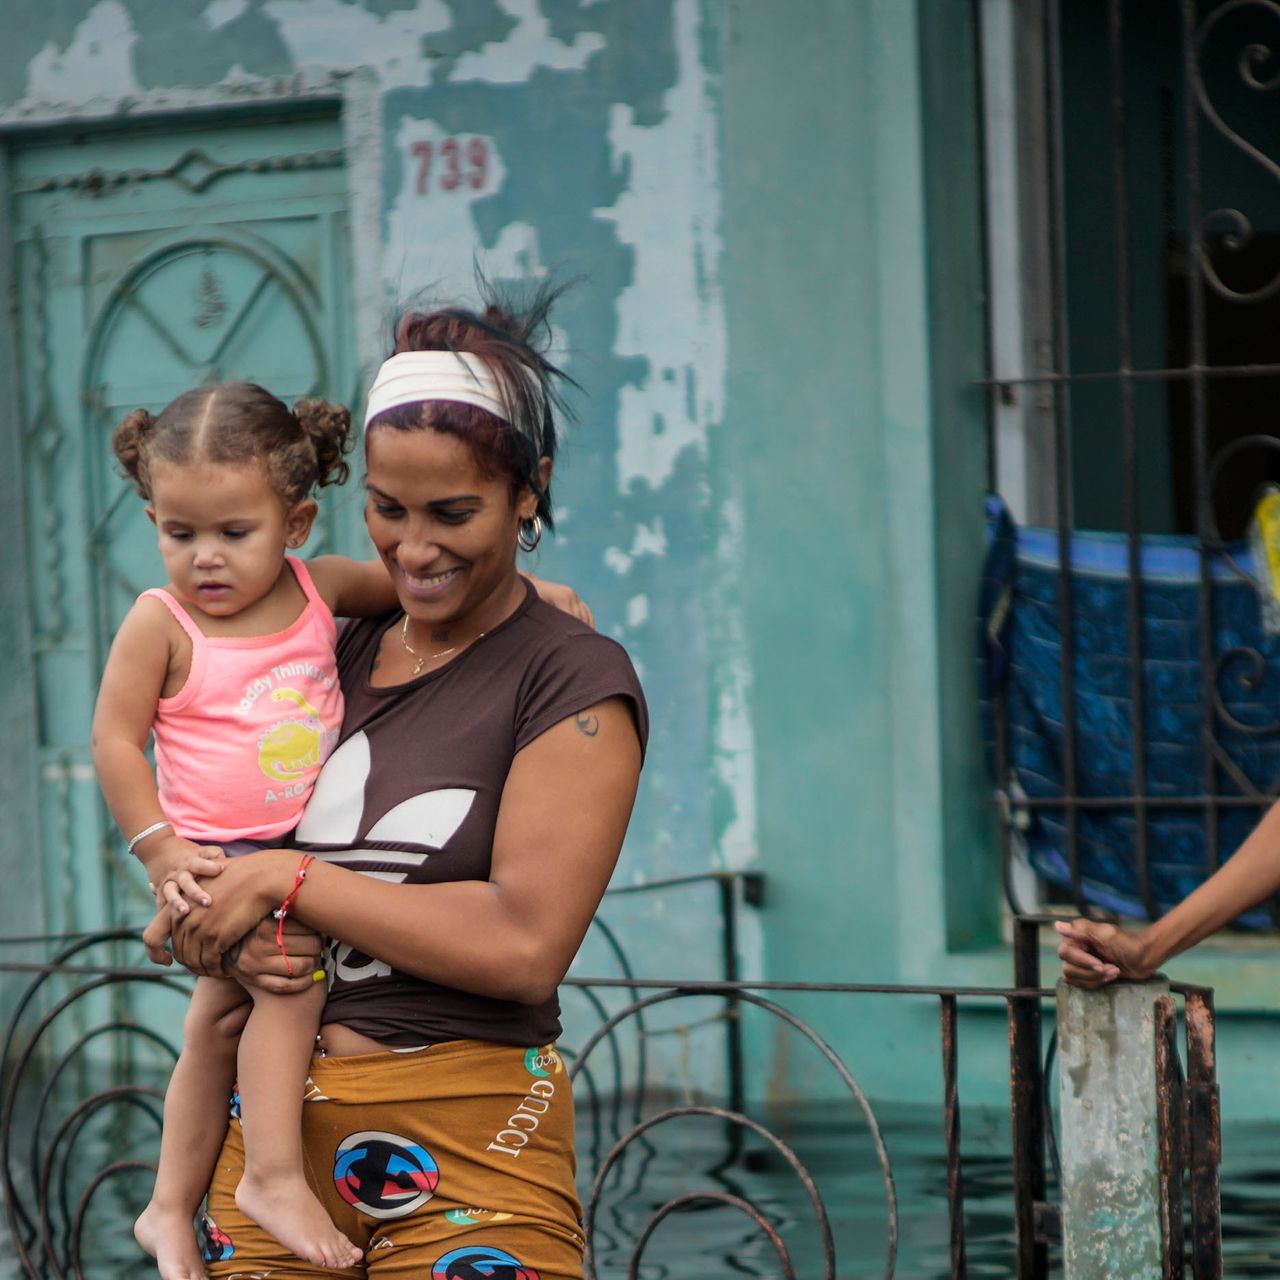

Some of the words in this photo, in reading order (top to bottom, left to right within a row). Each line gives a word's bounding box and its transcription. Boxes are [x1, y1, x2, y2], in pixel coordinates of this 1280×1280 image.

[410, 137, 488, 195] 739
[264, 781, 310, 804] A-RO
[486, 1080, 555, 1158] GUCCI
